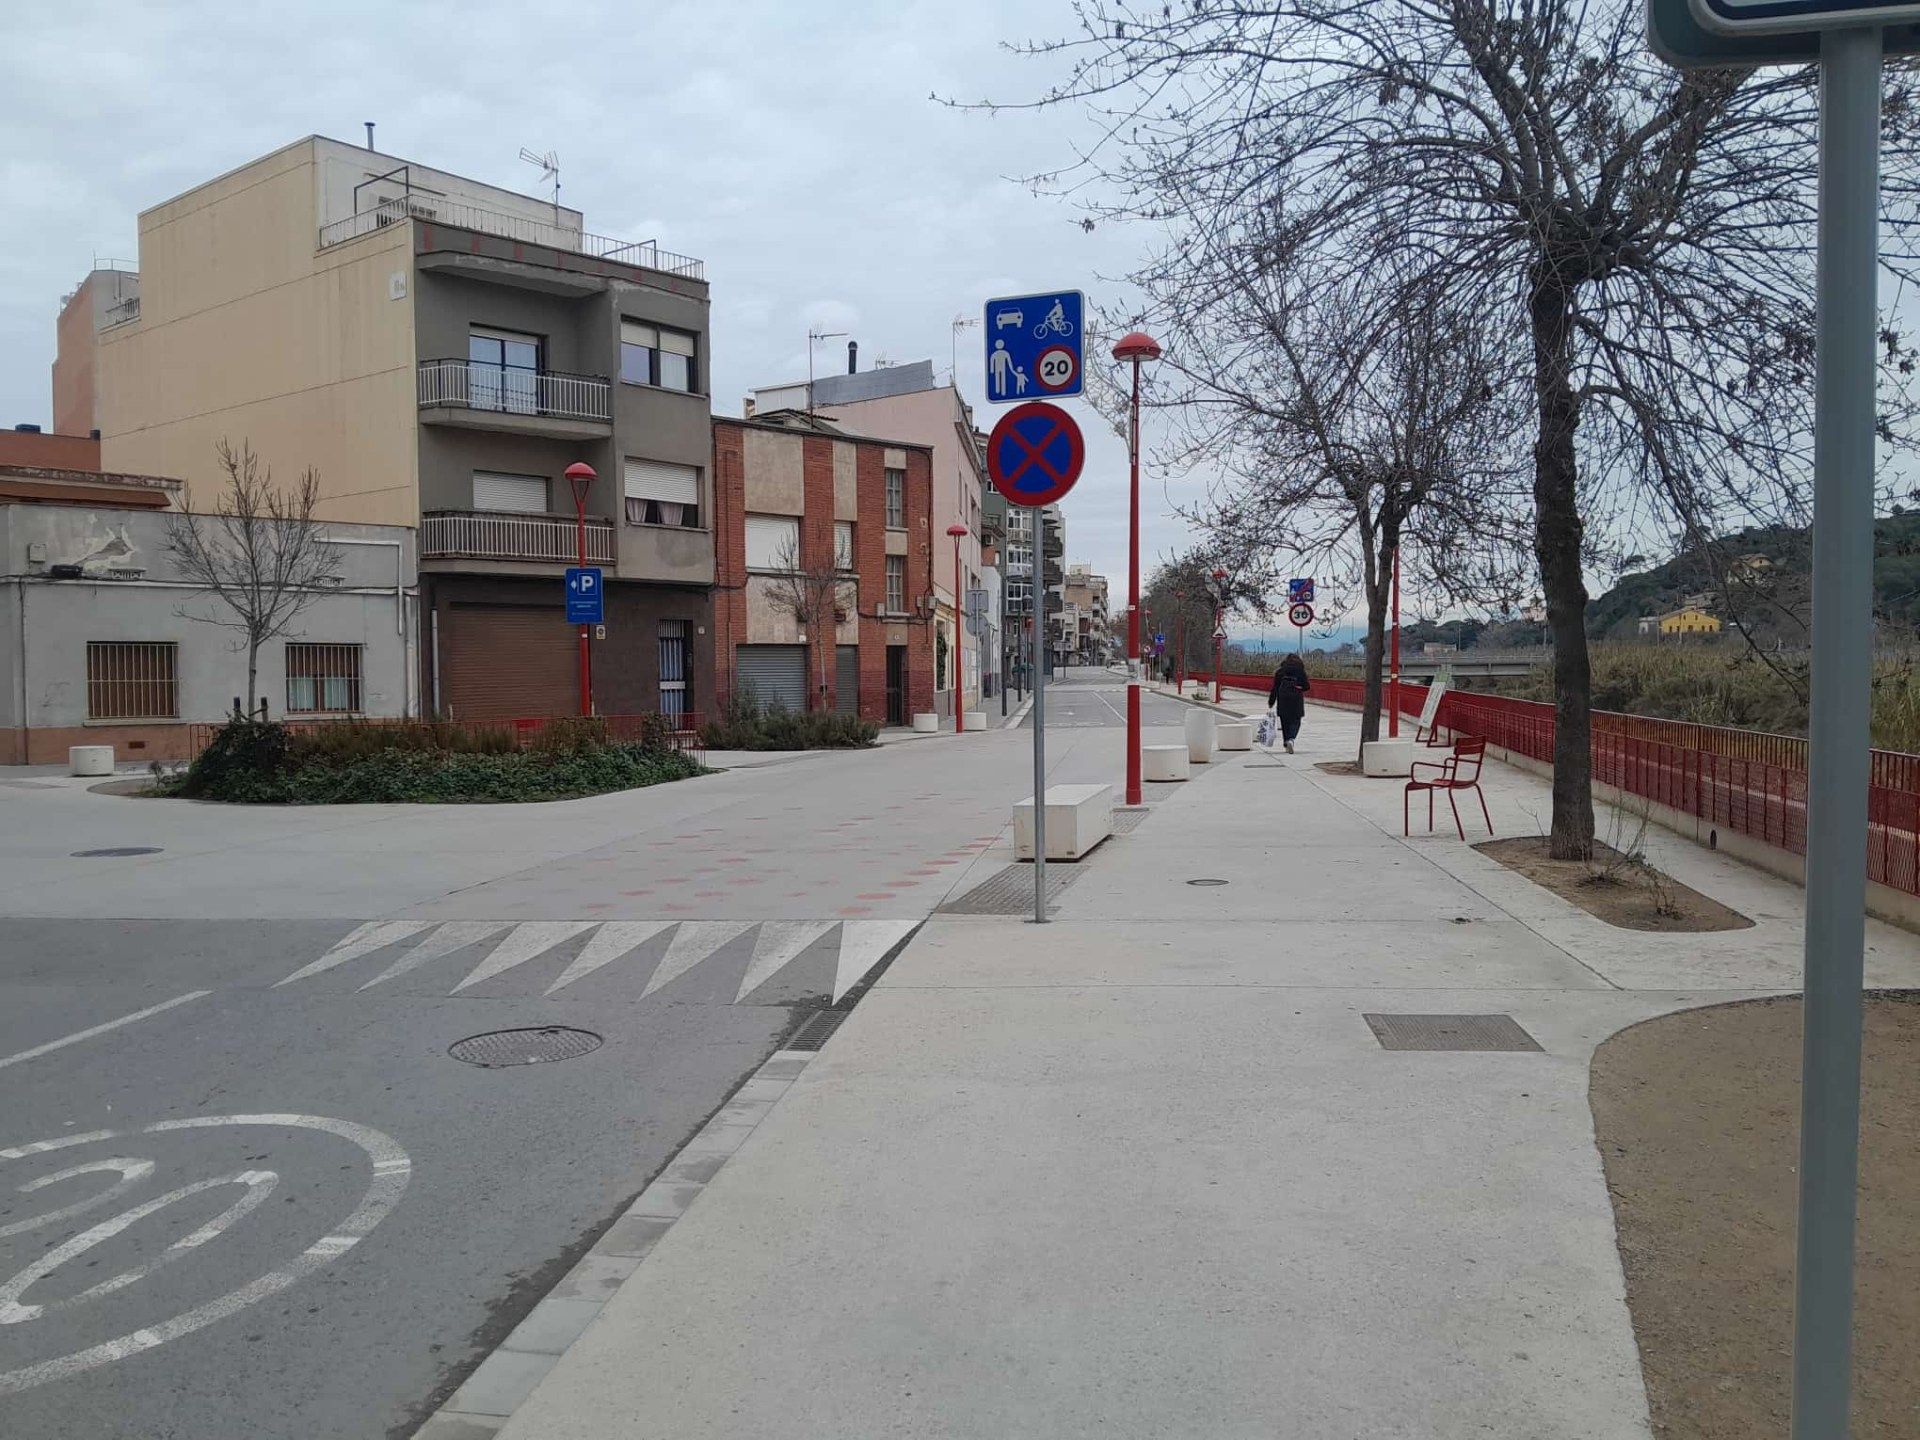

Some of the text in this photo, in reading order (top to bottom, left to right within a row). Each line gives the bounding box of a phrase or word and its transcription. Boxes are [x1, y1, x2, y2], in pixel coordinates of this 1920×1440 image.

[1044, 359, 1069, 377] 20
[581, 575, 594, 592] P
[1294, 611, 1308, 619] 30
